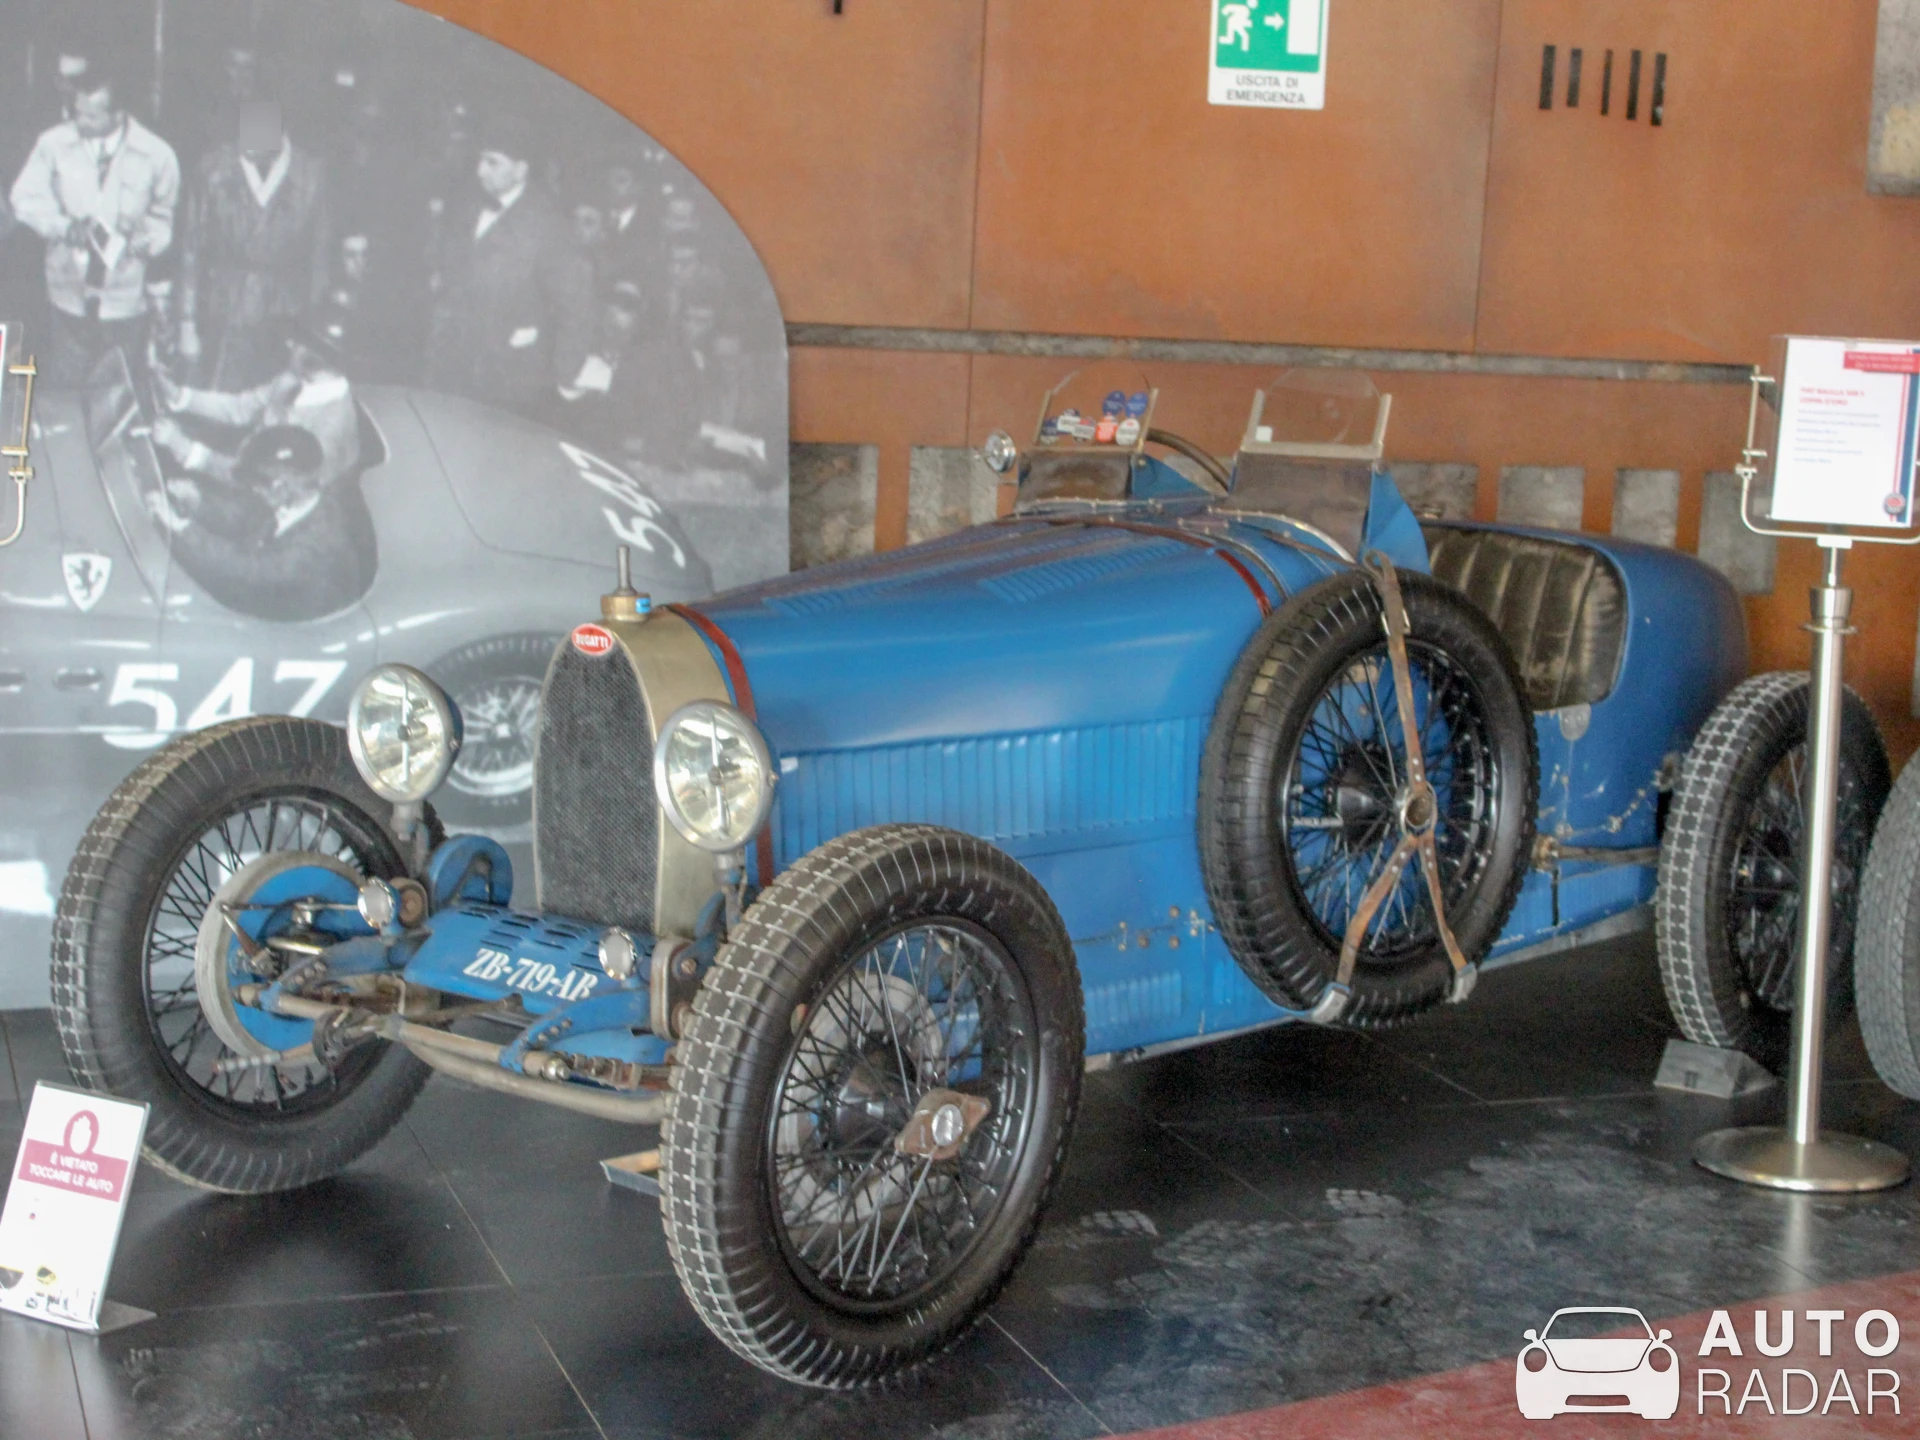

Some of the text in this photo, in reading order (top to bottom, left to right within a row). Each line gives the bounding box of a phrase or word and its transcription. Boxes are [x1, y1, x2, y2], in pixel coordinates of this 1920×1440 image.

[1236, 74, 1299, 88] USCITA DI
[1226, 88, 1306, 104] EMERGENZA
[574, 632, 610, 650] BUGATTI
[102, 656, 348, 750] 547
[60, 1155, 98, 1174] VIETATO
[29, 1163, 114, 1194] TOCCARE LE AUTO
